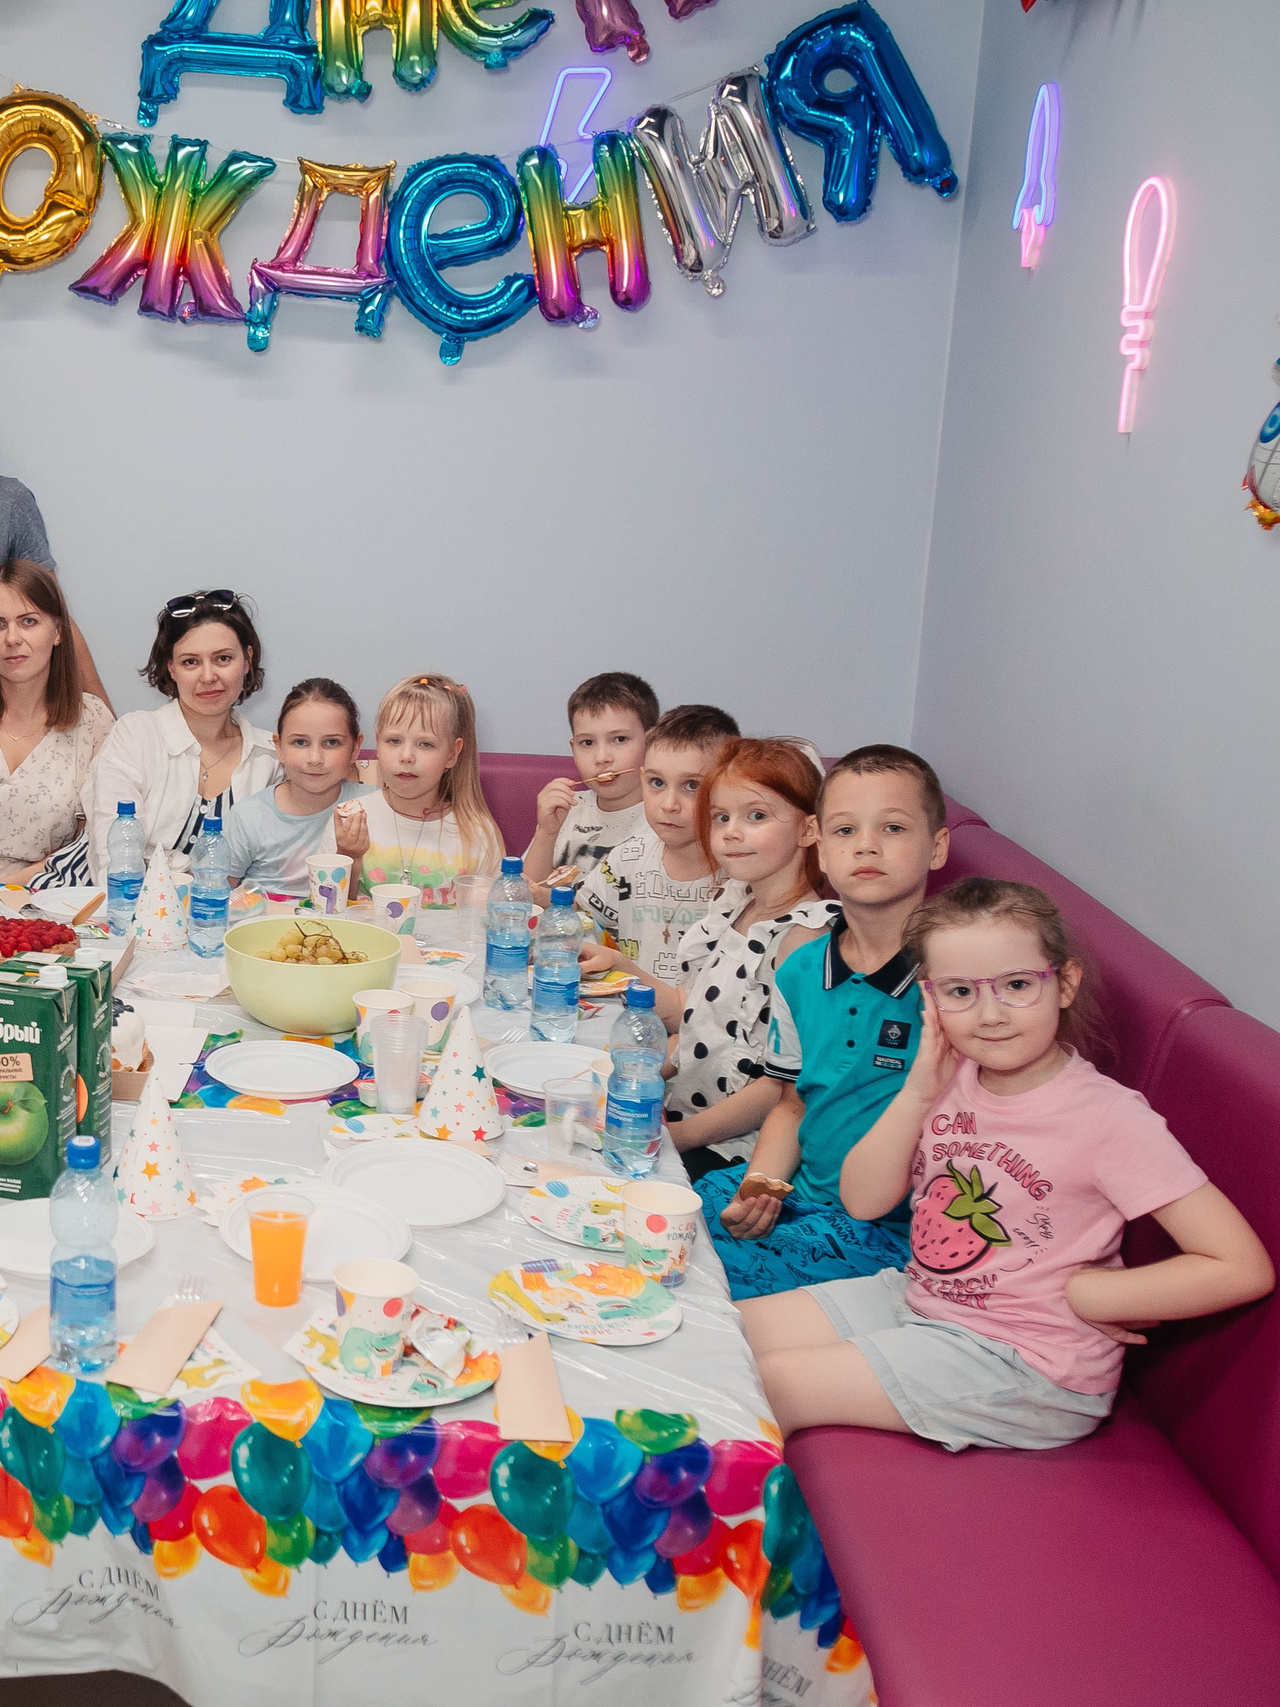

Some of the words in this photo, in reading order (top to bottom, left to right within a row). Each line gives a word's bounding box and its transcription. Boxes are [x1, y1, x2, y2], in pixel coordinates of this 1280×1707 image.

[931, 1111, 977, 1136] CAN
[931, 1140, 1054, 1201] SOMETHING
[937, 1273, 998, 1294] EACH
[78, 1570, 94, 1589] С
[99, 1566, 161, 1600] ДНЁМ
[313, 1600, 328, 1620] С
[333, 1599, 409, 1625] ДНЁМ
[574, 1622, 592, 1641] С
[596, 1620, 675, 1645] ДНЁМ
